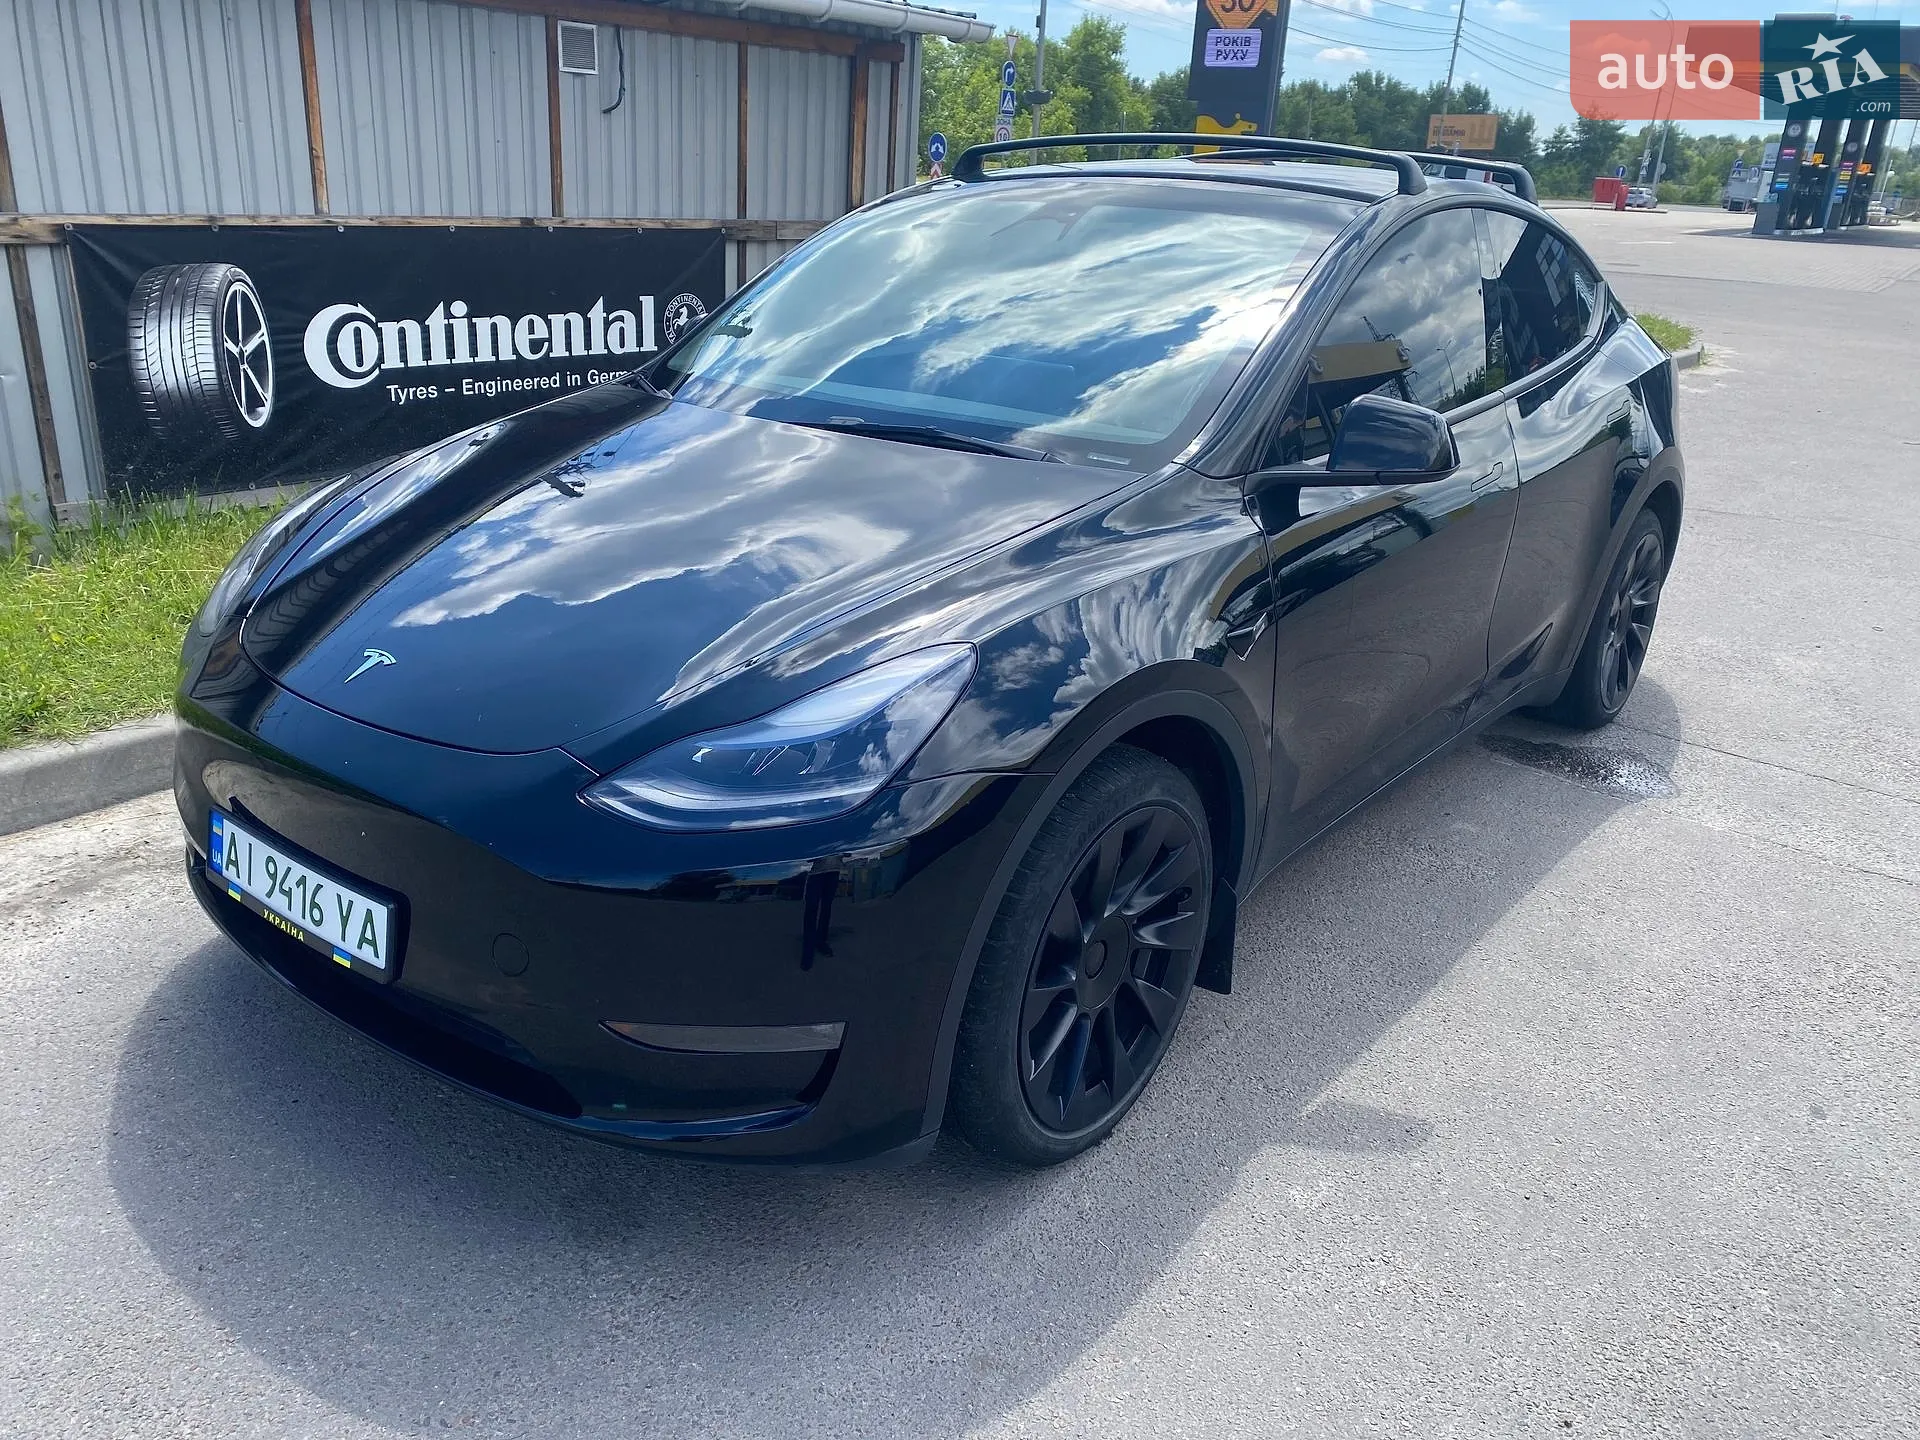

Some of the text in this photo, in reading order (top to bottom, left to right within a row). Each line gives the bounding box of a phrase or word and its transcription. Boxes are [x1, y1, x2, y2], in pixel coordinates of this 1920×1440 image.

[1215, 36, 1252, 47] РОКІВ
[1216, 49, 1249, 61] РУХУ
[303, 295, 658, 389] Continental
[386, 384, 438, 405] Tyres
[462, 373, 561, 397] Engineered
[567, 371, 582, 387] in
[212, 848, 222, 867] UA
[225, 832, 380, 959] AI 9416 YA
[263, 908, 304, 942] УКРАЇНА
